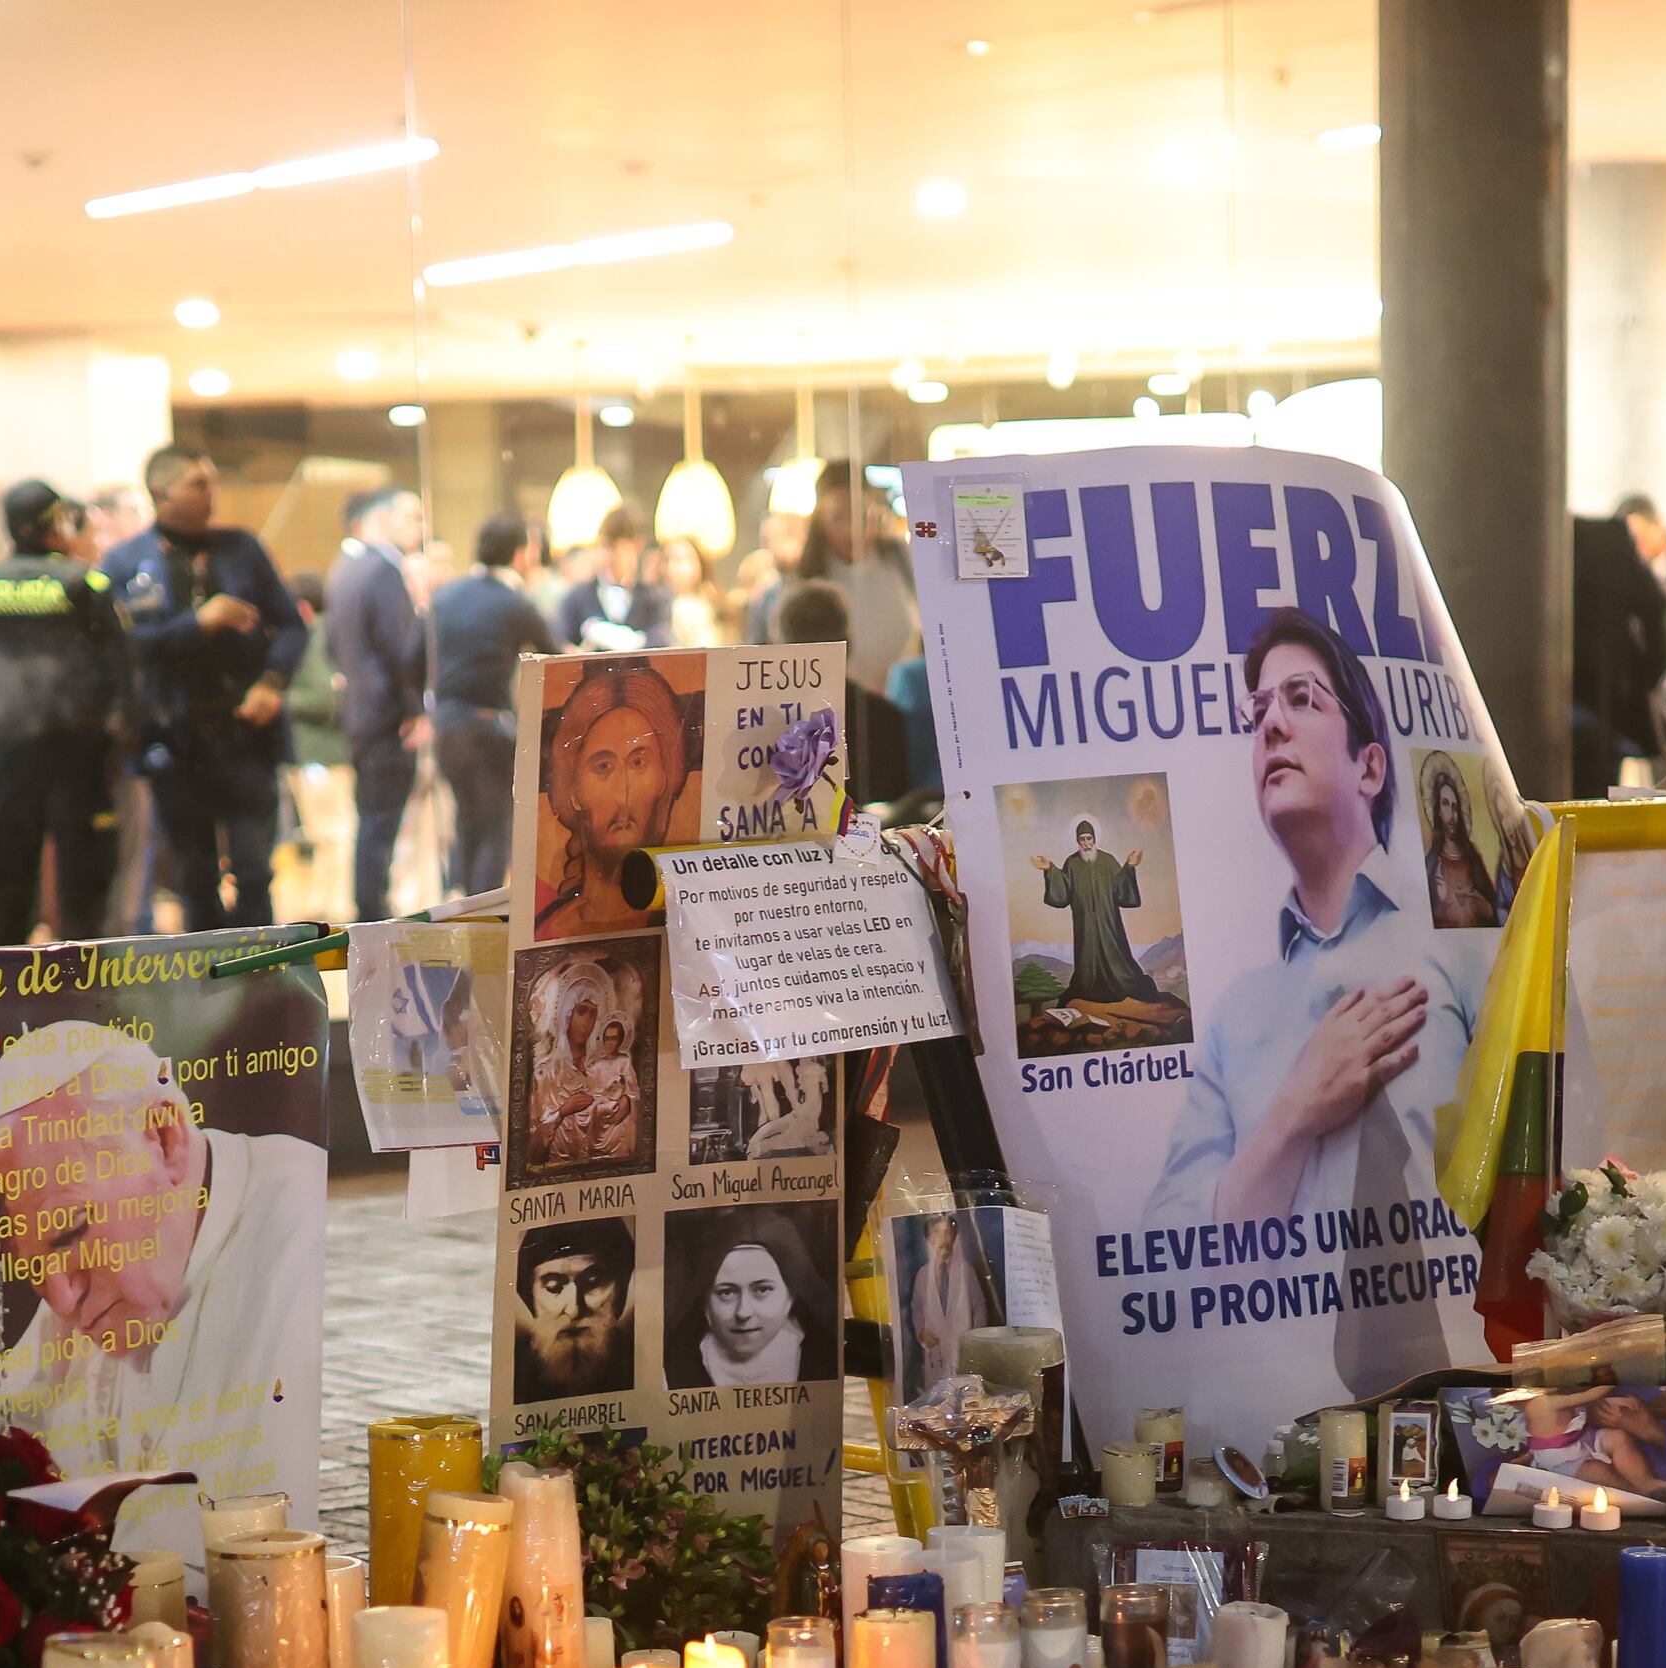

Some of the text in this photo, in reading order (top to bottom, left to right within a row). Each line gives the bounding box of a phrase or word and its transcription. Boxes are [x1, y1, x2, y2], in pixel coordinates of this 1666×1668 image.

[988, 481, 1444, 669] FUERZ
[736, 658, 822, 691] JESUS
[737, 702, 802, 730] EN TI
[1000, 662, 1251, 750] MIGUEL
[1386, 666, 1486, 746] URIB
[720, 798, 818, 842] SANA A
[672, 848, 834, 875] Un detalle con luz y
[679, 871, 908, 906] Por motivos de seguridad y respeto
[734, 899, 868, 928] por nuestro entorno,
[695, 916, 913, 952] te invitamos a usar velas LED en
[18, 952, 64, 995] de
[75, 935, 288, 991] Intersecció
[735, 941, 887, 972] lugar de velas de cera.
[734, 975, 781, 998] juntos
[784, 967, 848, 987] cuidamos
[851, 964, 865, 979] el
[866, 958, 914, 980] espacio
[916, 958, 926, 975] y
[815, 990, 844, 1006] viva
[846, 987, 860, 1001] la
[862, 979, 925, 1001] intención.
[67, 1016, 154, 1056] partido
[693, 1037, 760, 1061] ¡Gracias
[791, 1031, 806, 1047] tu
[811, 1016, 898, 1045] comprensión
[900, 1020, 908, 1036] y
[911, 1014, 925, 1030] tu
[928, 1008, 952, 1028] luz!
[66, 1072, 82, 1097] a
[91, 1061, 147, 1095] Dios
[177, 1056, 219, 1089] por
[225, 1048, 239, 1076] ti
[246, 1042, 318, 1078] amigo
[1021, 1062, 1074, 1094] San
[22, 1103, 124, 1147] Trinidad
[55, 1153, 88, 1186] de
[96, 1147, 153, 1181] Dios
[672, 1161, 839, 1202] San Miguel Arcangel
[36, 1203, 76, 1242] por
[83, 1198, 110, 1229] tu
[510, 1184, 635, 1225] SANTA MARIA
[1096, 1215, 1307, 1277] ELEVEMOS
[1315, 1206, 1384, 1254] UNA
[1389, 1197, 1473, 1246] ORAC
[1, 1246, 70, 1287] llegar
[79, 1229, 163, 1275] Miguel
[1122, 1253, 1479, 1335] SU PRONTA RECUPER
[41, 1332, 95, 1368] pido
[102, 1329, 117, 1354] a
[125, 1316, 183, 1351] Dios
[515, 1401, 626, 1437] SAN CHARBEL
[668, 1385, 810, 1416] SANTA TERESITA
[692, 1470, 728, 1494] POR
